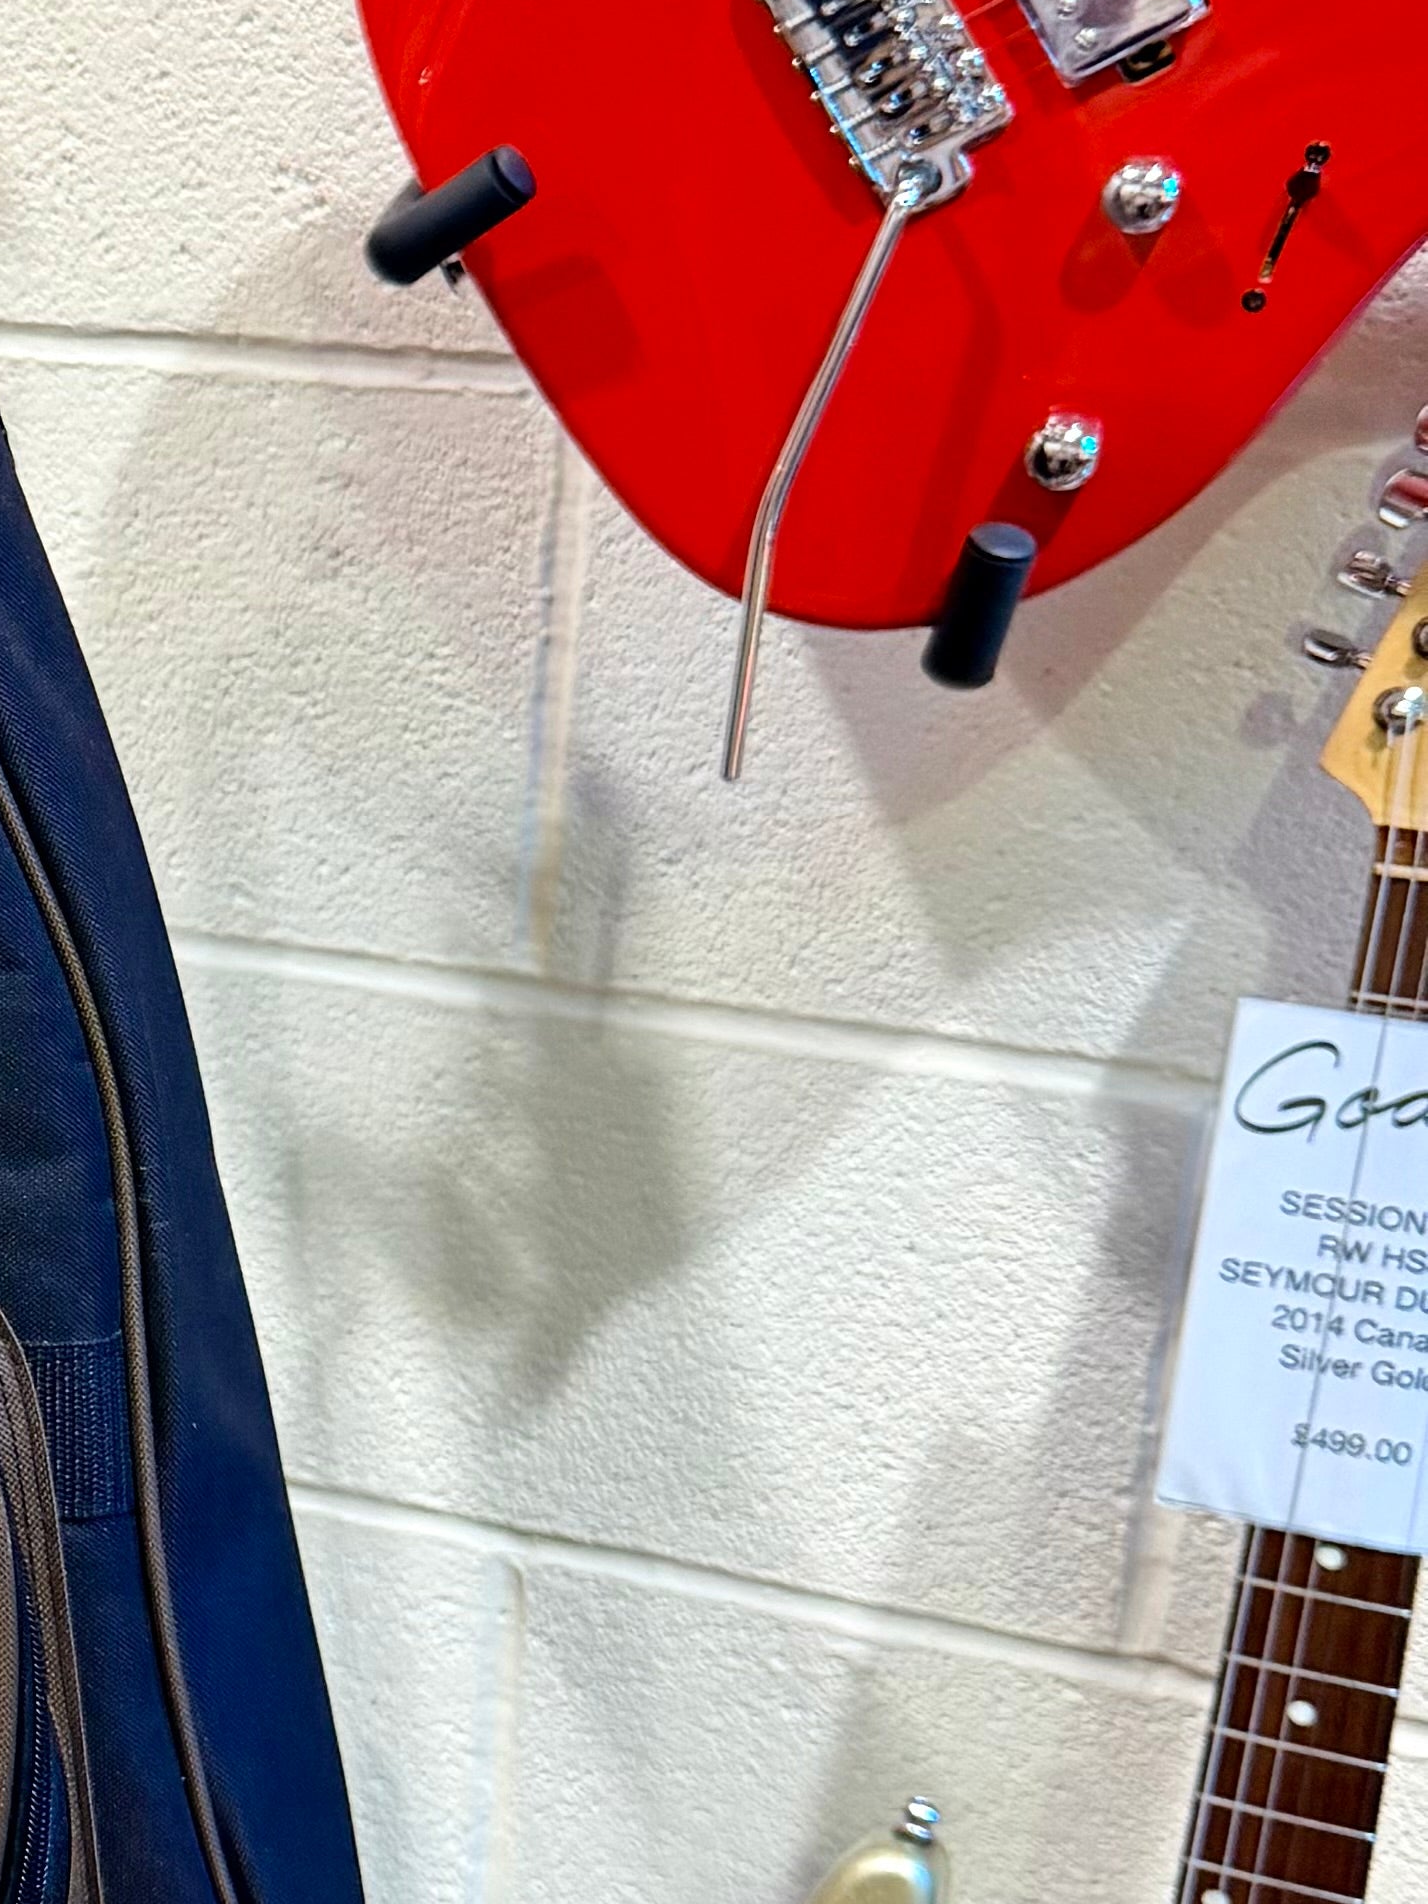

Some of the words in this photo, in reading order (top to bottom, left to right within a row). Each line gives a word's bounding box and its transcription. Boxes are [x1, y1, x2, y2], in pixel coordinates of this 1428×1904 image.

[1279, 1189, 1428, 1236] SESSION
[1316, 1233, 1374, 1265] RW
[1218, 1256, 1385, 1306] SEYMOUR
[1271, 1303, 1345, 1337] 2014
[1278, 1343, 1364, 1380] Silver
[1290, 1421, 1413, 1466] £499.00
